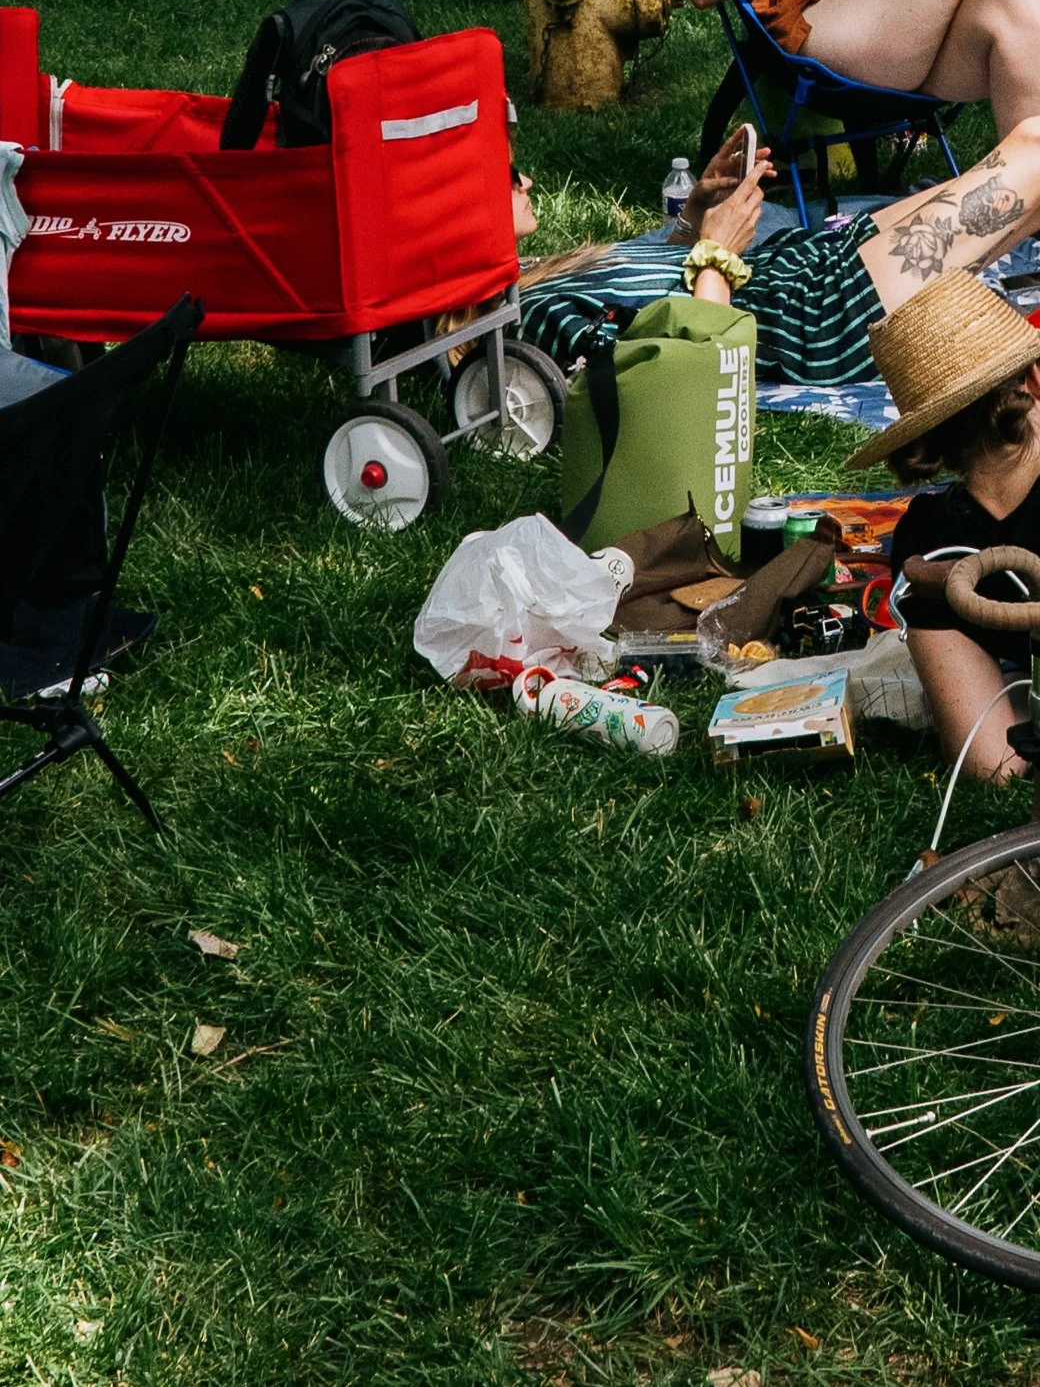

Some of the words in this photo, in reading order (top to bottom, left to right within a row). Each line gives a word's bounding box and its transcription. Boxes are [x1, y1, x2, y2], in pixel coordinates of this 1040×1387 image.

[29, 216, 73, 232] DIO
[107, 223, 191, 243] FLYER
[713, 347, 739, 534] ICEMULE
[741, 355, 749, 452] COOLERS
[815, 1014, 836, 1111] GATORSKIN
